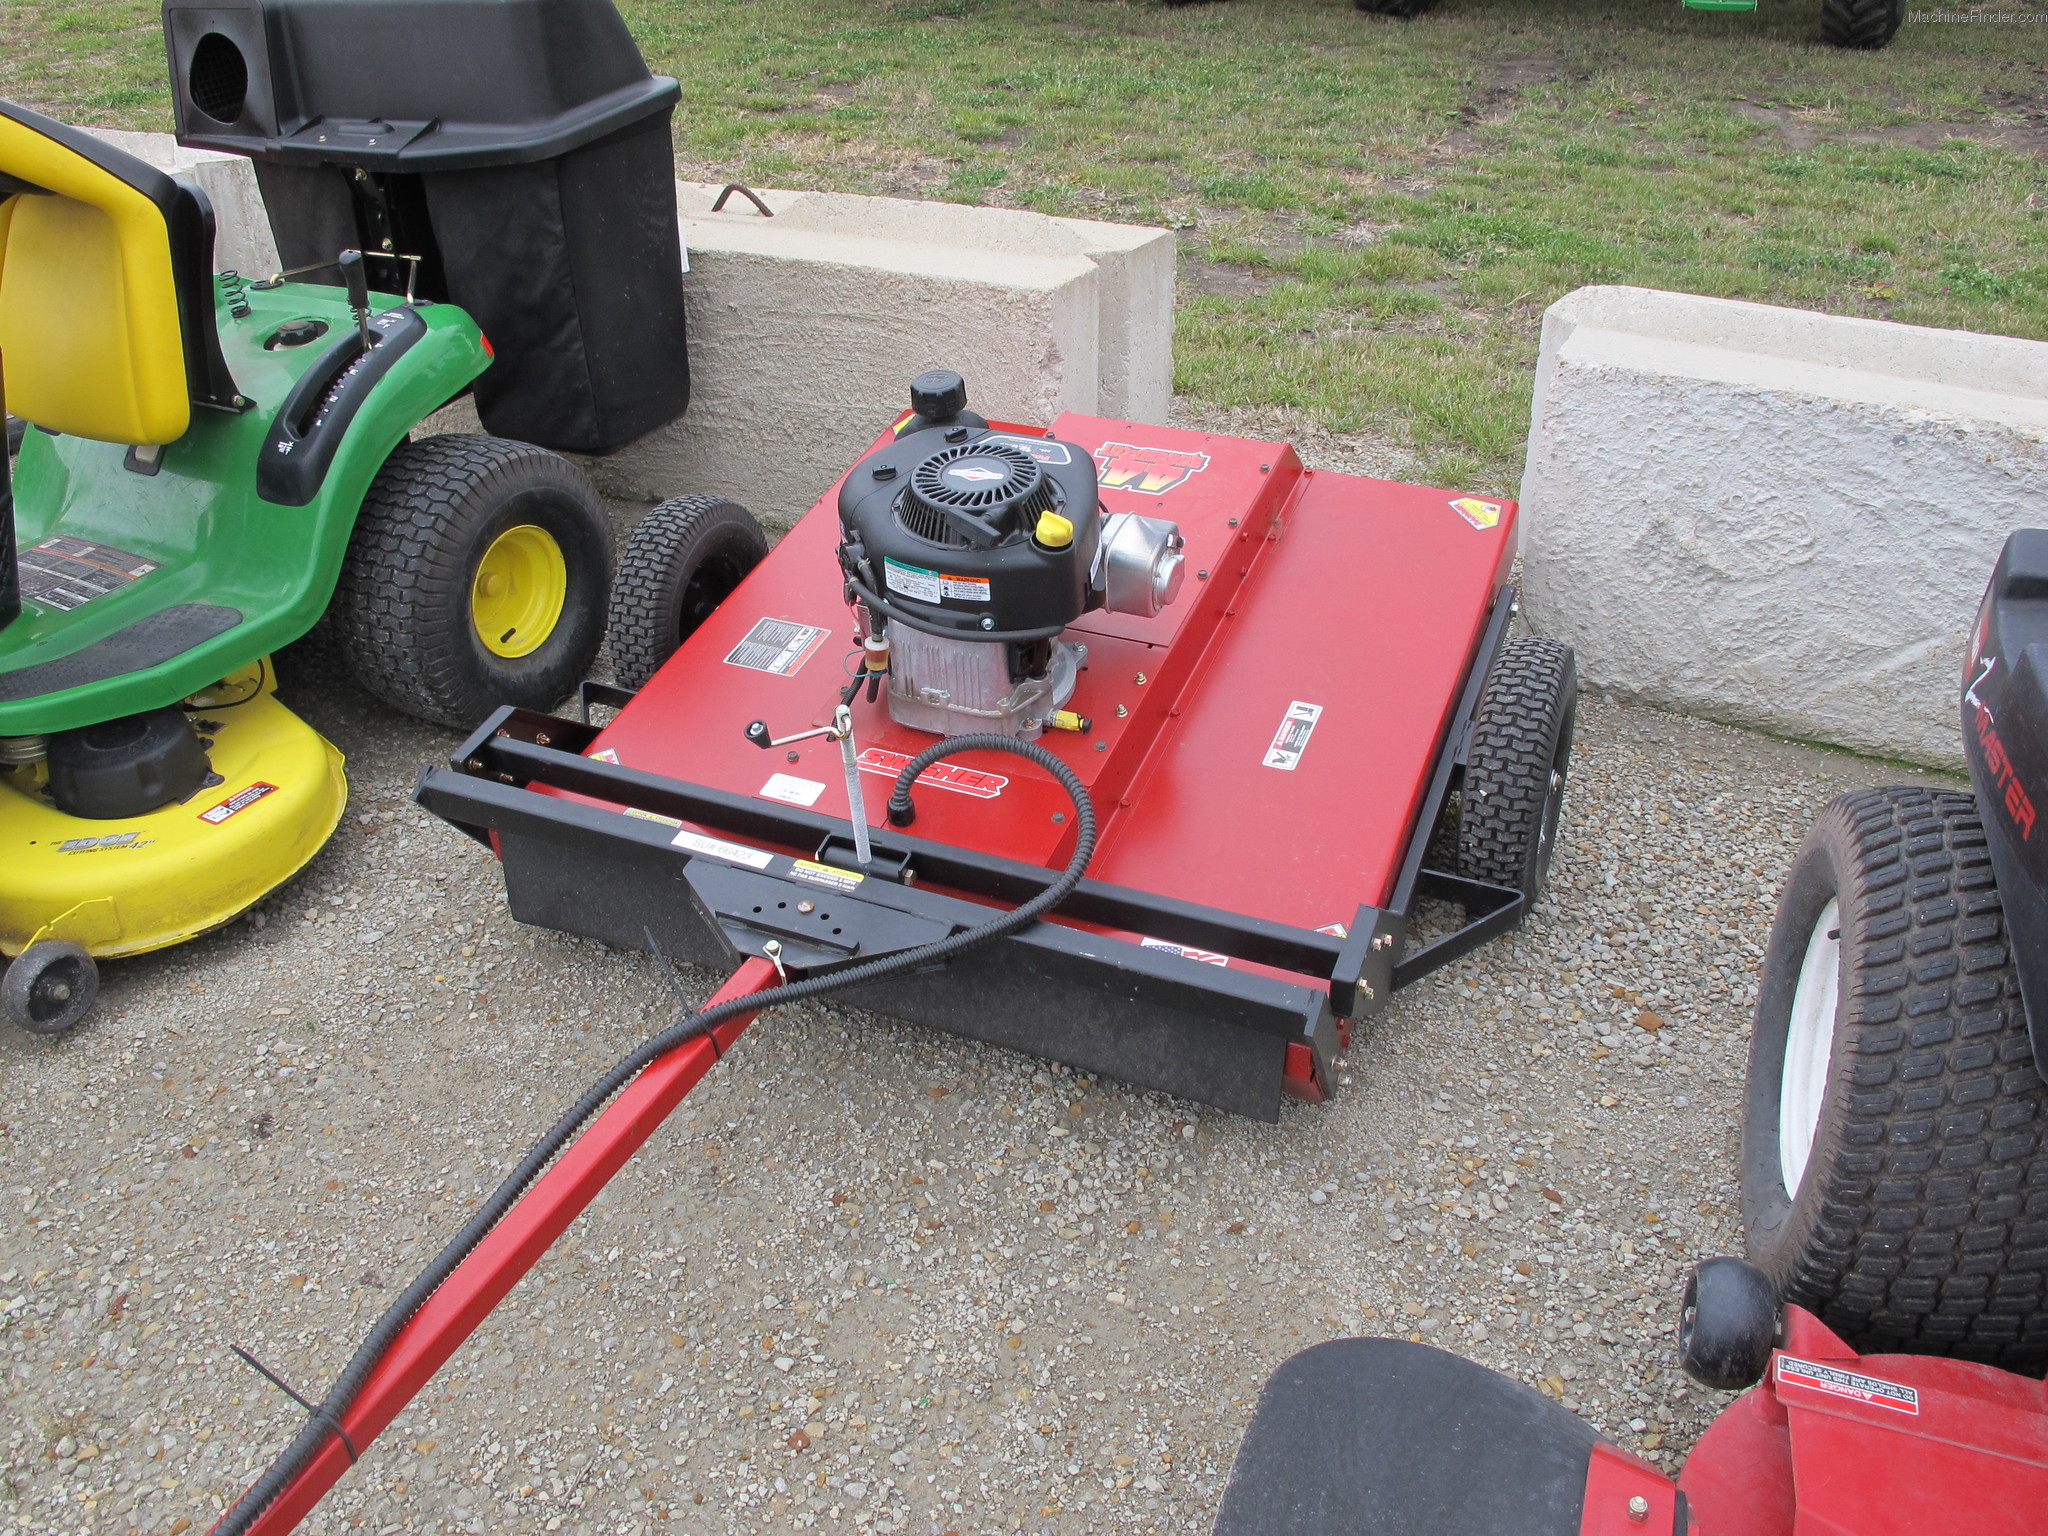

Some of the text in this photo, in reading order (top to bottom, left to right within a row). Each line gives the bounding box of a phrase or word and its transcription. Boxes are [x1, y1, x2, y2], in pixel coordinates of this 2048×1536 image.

[859, 750, 1003, 791] SWSHER
[56, 831, 141, 852] EDGE
[68, 847, 98, 856] CUTTING
[99, 844, 128, 853] SYSTEM
[693, 839, 752, 860] SU# 66423
[796, 861, 861, 880] CAUTION ATTENTION
[816, 872, 839, 881] EXCEED
[1785, 1364, 1814, 1376] UNLESS
[1823, 1369, 1850, 1380] FIRMLY
[1815, 1372, 1832, 1381] UNIT
[1833, 1376, 1849, 1385] THIS
[1820, 1380, 1861, 1398] DANGER
[1851, 1381, 1885, 1394] OPERATE
[1867, 1380, 1898, 1391] SHIELDS
[1886, 1390, 1902, 1399] NOT
[1899, 1388, 1914, 1396] ALL
